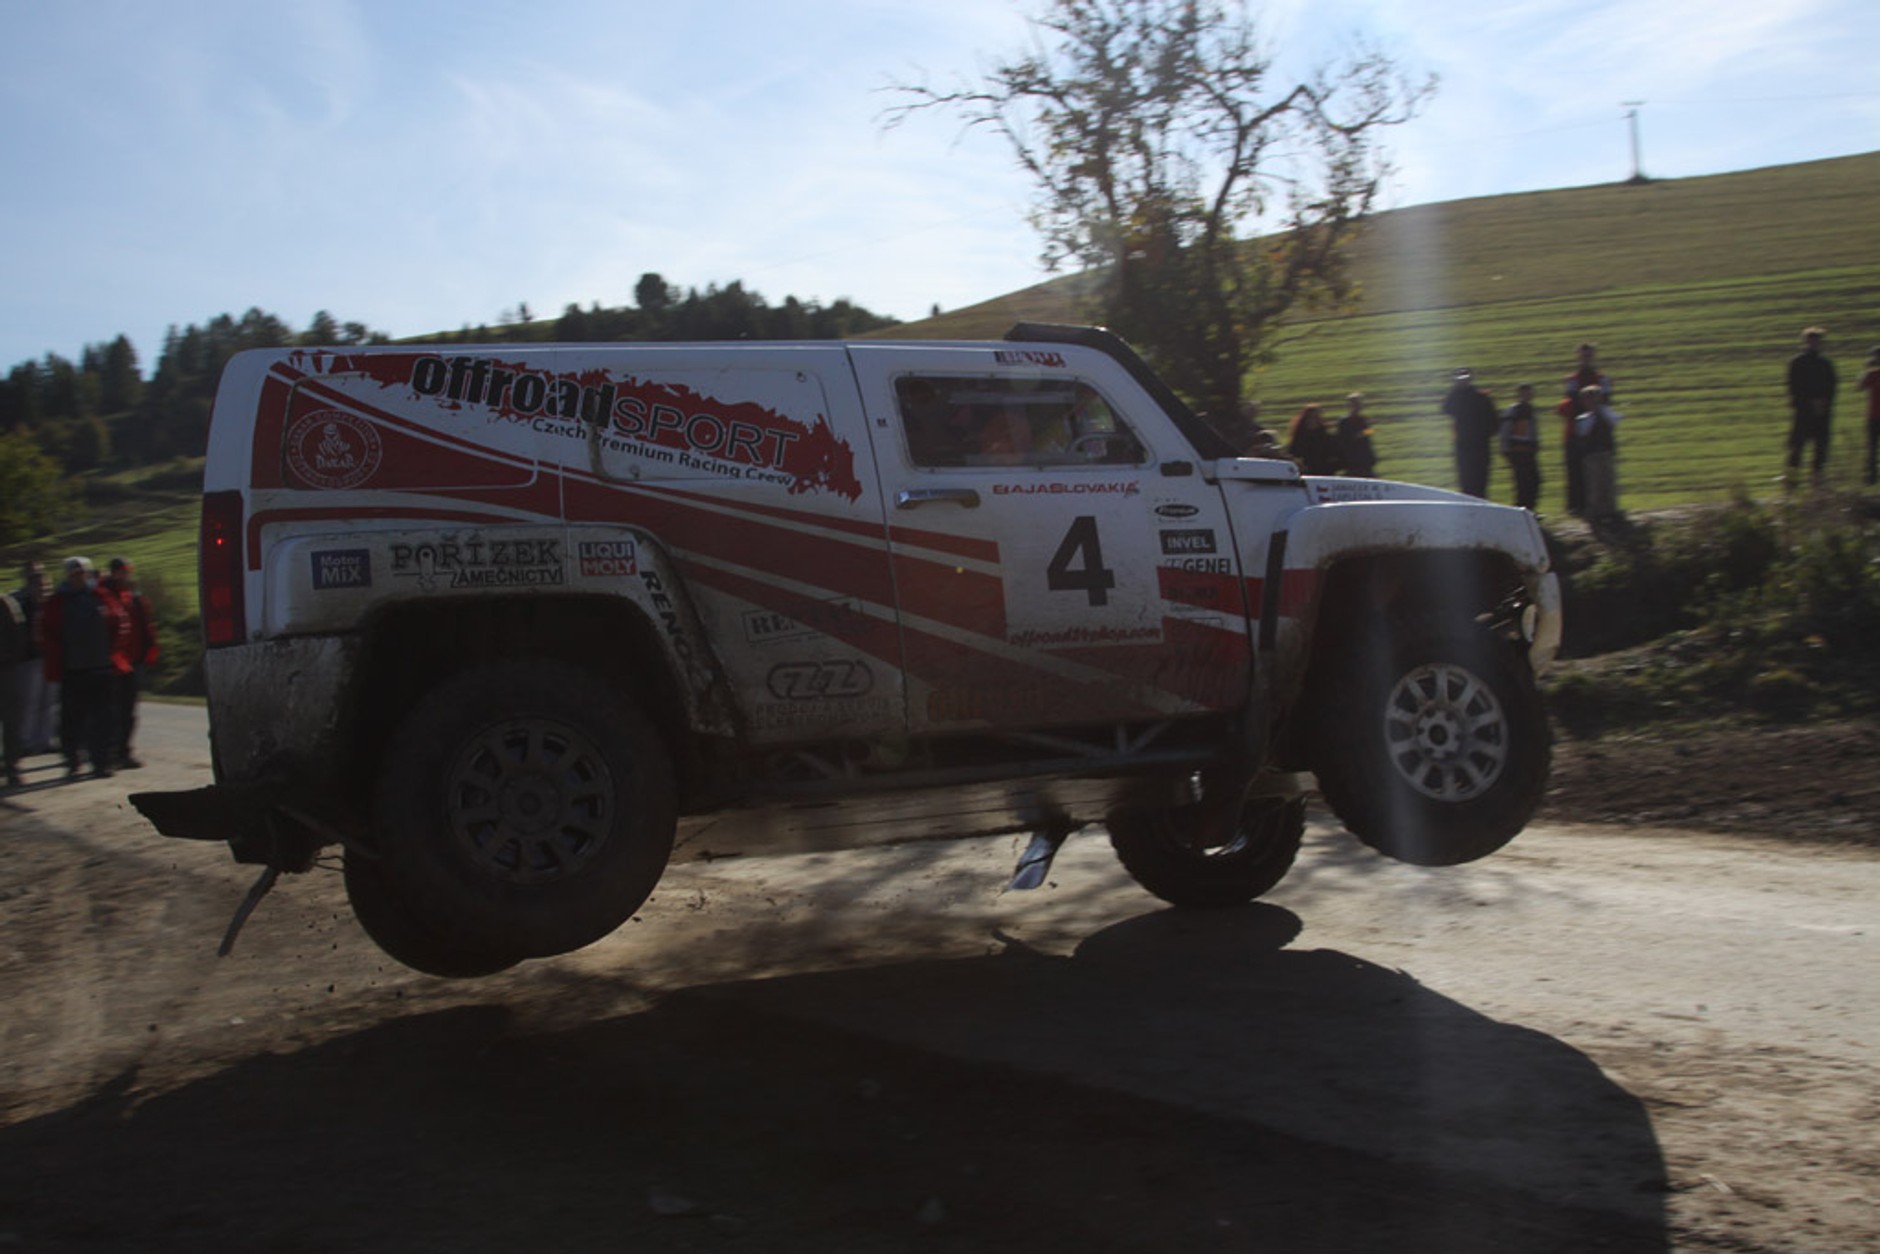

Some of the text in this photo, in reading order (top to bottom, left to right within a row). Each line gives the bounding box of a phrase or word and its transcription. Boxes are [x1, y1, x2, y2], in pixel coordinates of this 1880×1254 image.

[532, 418, 588, 440] Czech
[679, 452, 741, 478] Racing
[745, 467, 793, 486] Crew
[1166, 535, 1211, 549] INVEL
[580, 543, 633, 559] LIQUI
[320, 555, 361, 568] Motor
[582, 559, 636, 575] MOLY
[1046, 516, 1115, 606] 4
